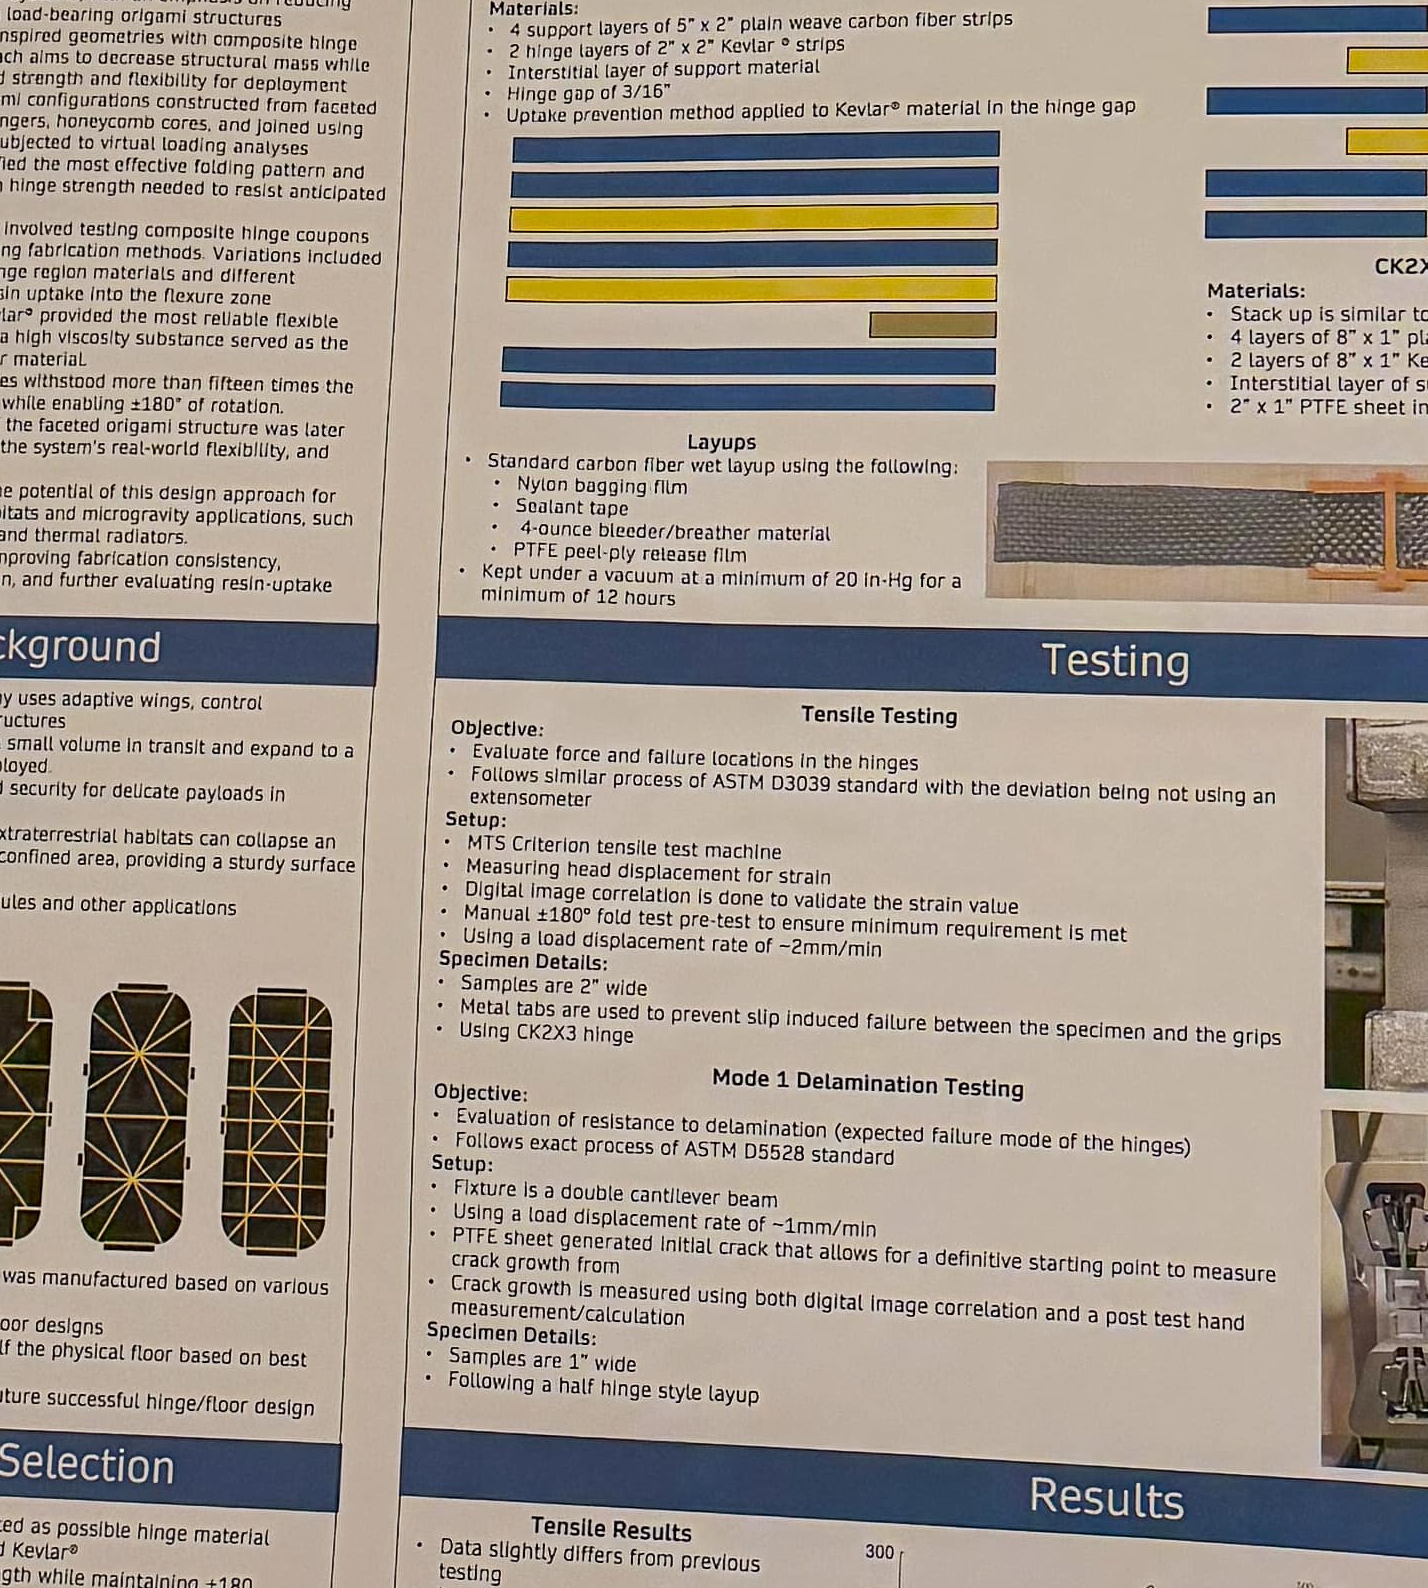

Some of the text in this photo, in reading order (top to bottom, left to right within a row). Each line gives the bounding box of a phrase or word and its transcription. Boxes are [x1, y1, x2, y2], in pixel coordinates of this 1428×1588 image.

[688, 433, 757, 454] Layups
[517, 475, 690, 498] Nylon bagging film
[1041, 642, 1189, 686] Testing
[18, 693, 56, 707] uses
[61, 691, 134, 710] adaptive
[140, 692, 194, 713] wings,
[201, 695, 263, 711] control
[801, 704, 958, 729] Tensile Testing
[451, 719, 544, 739] Objective:
[713, 1067, 1024, 1103] Mode 1 Delamination Testing
[451, 1251, 620, 1275] crack growth from
[1031, 1476, 1185, 1520] Results
[531, 1515, 692, 1543] Tensile Results
